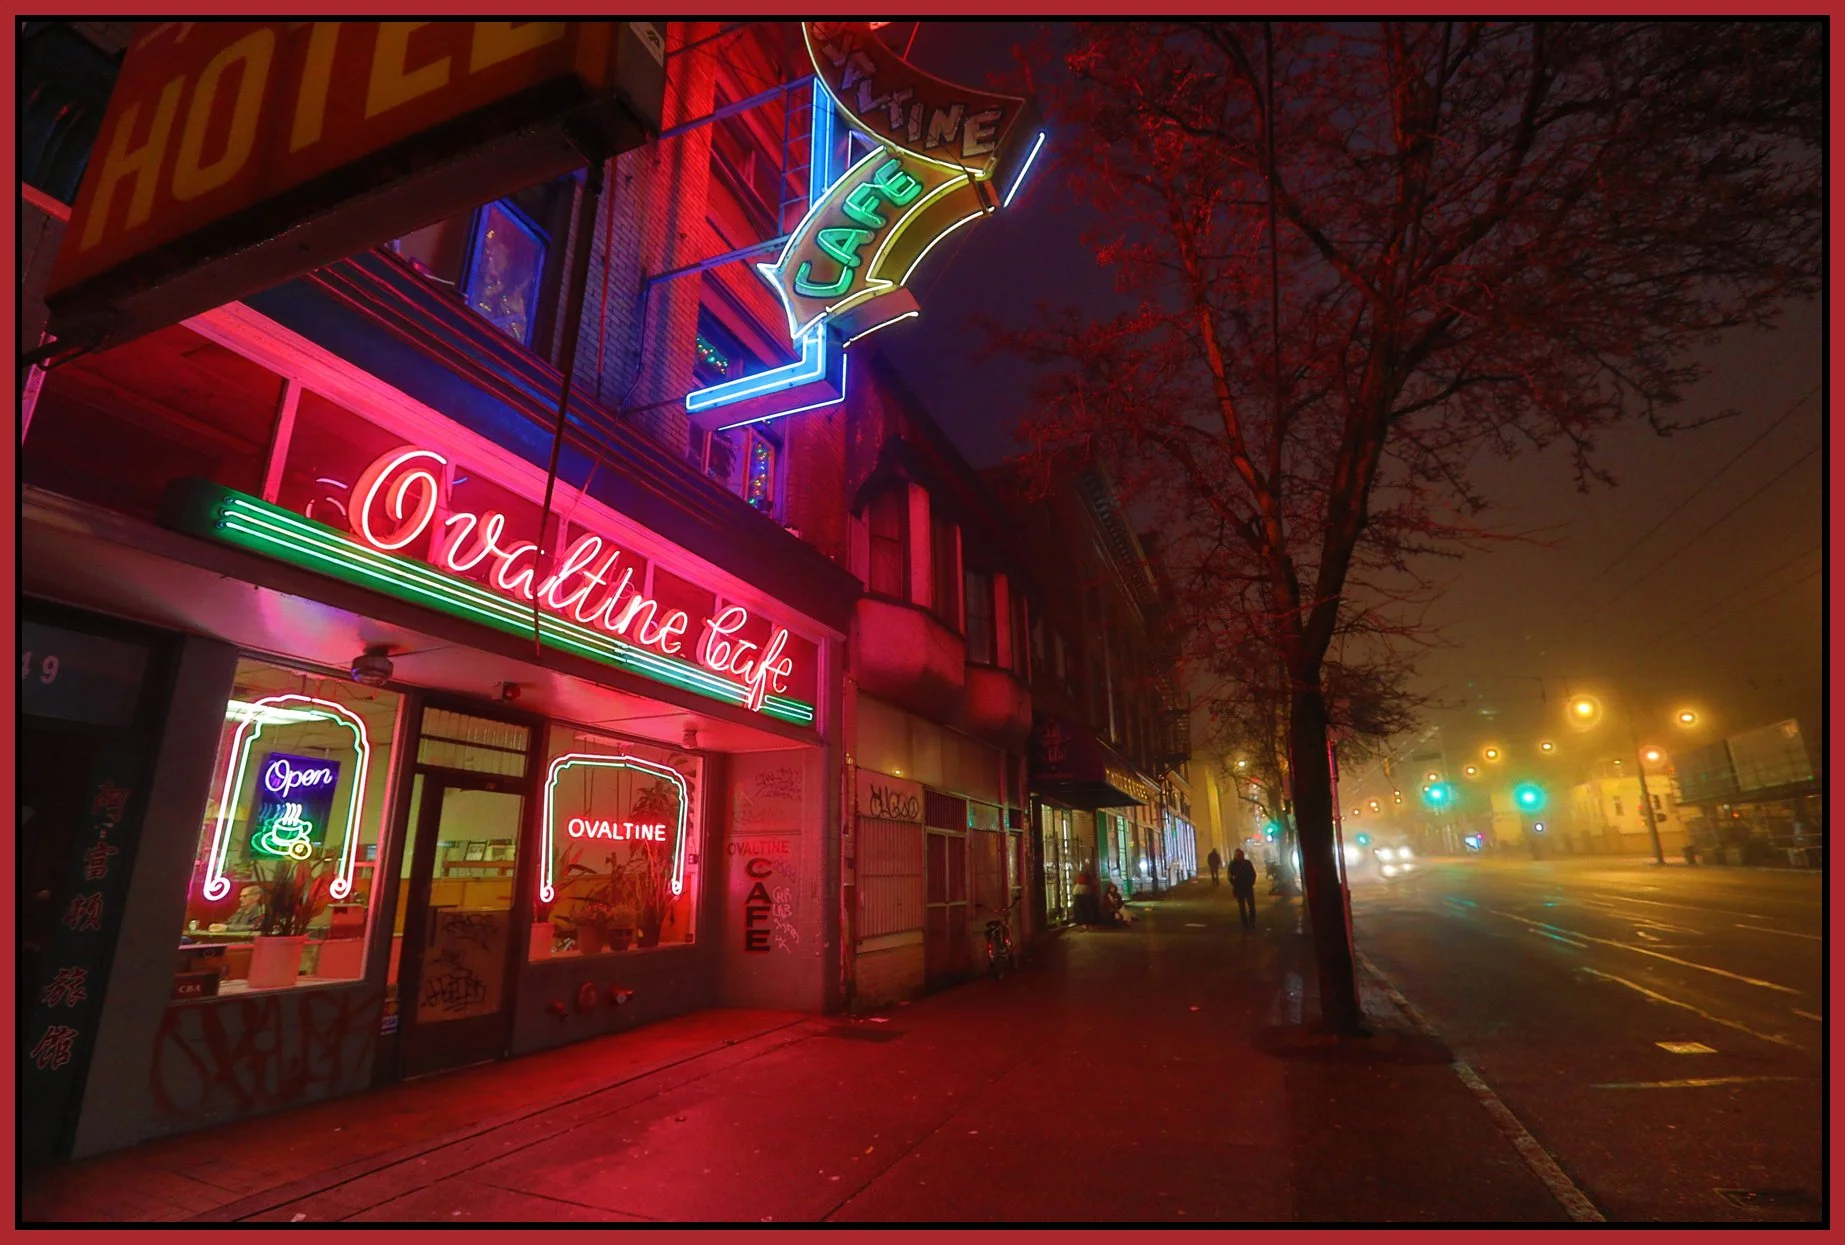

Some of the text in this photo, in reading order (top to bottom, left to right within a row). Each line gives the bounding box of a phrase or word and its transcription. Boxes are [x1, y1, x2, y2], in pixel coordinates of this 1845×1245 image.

[80, 22, 566, 253] HOTE
[793, 158, 923, 298] CAFE
[350, 446, 793, 712] Ovaltine Cafe
[265, 759, 333, 798] Open
[568, 818, 667, 841] OVALTINE
[727, 840, 790, 857] OVALTINE
[744, 857, 773, 952] CAFE
